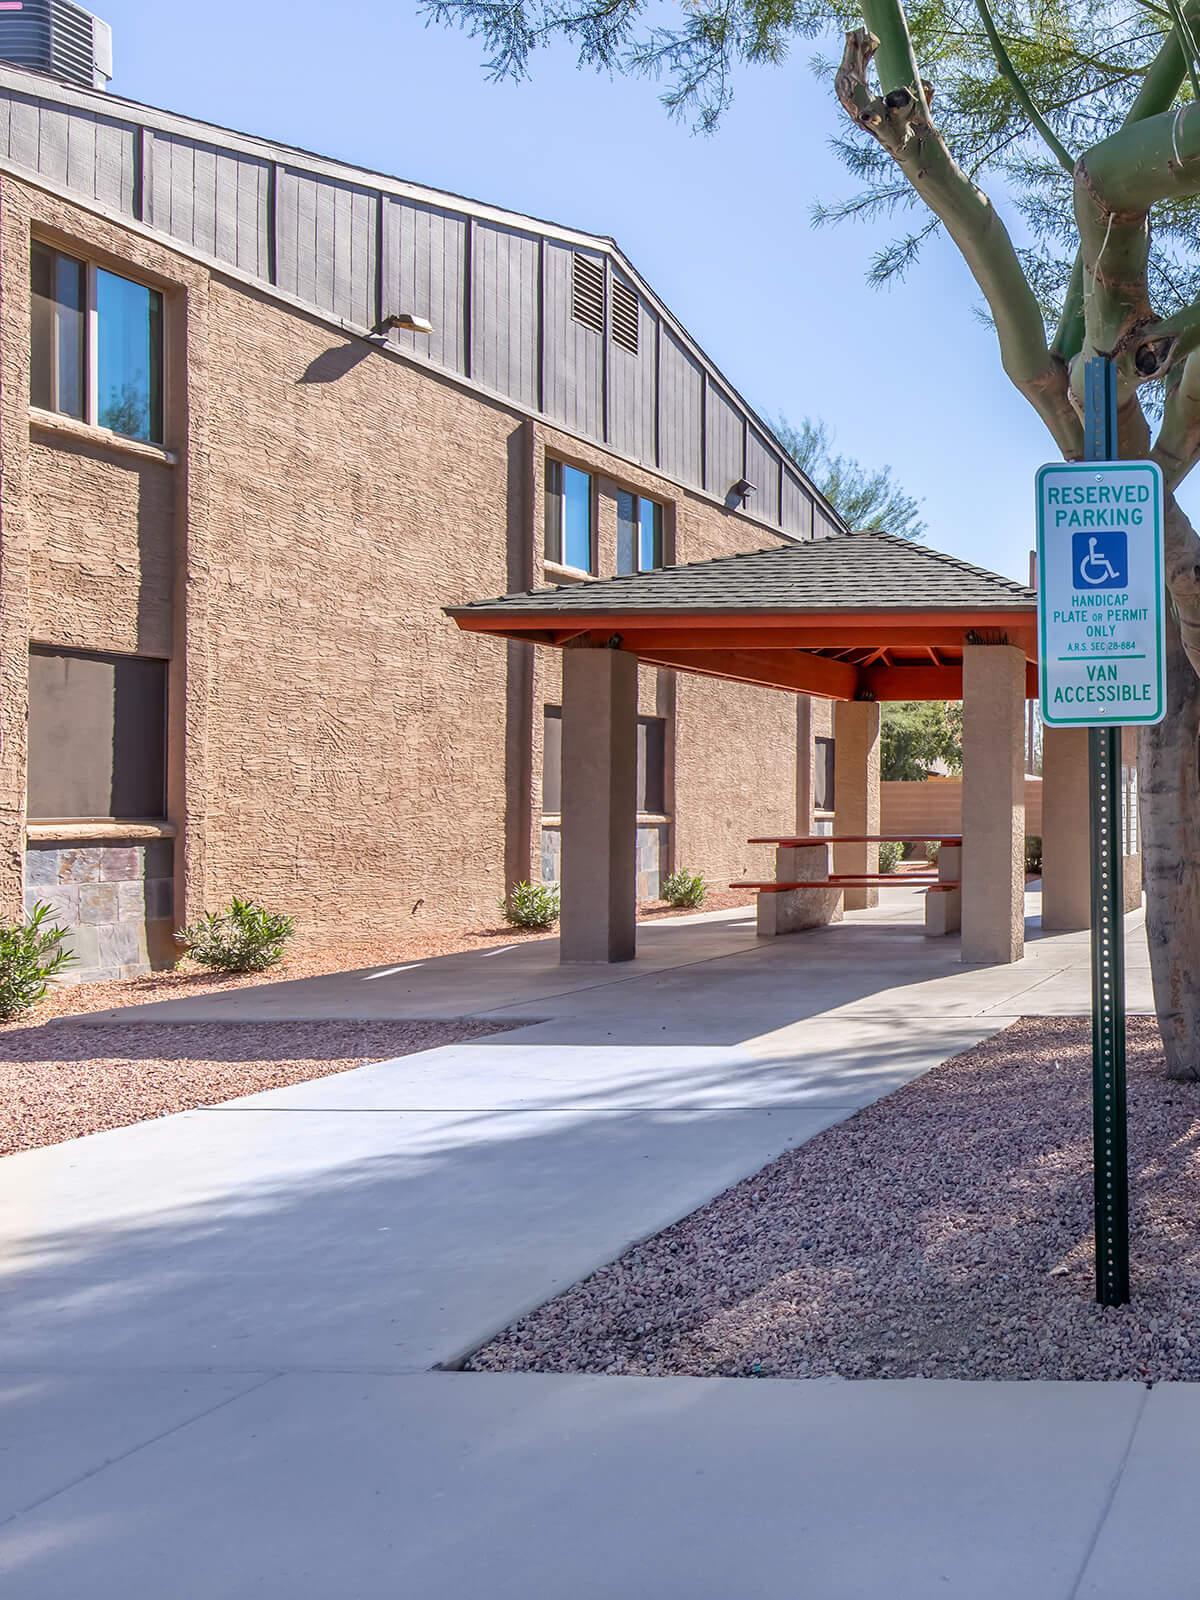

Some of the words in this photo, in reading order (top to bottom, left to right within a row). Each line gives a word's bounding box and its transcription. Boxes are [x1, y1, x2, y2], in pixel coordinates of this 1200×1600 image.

[1048, 485, 1149, 504] RESERVED
[1055, 508, 1143, 527] PARKING
[1072, 594, 1128, 607] HANDICAP
[1054, 610, 1088, 622] PLATE
[1092, 613, 1103, 621] OR
[1107, 608, 1148, 621] PERMIT
[1086, 625, 1116, 637] ONLY
[1086, 665, 1117, 681] VAN
[1054, 684, 1151, 703] ACCESSIBLE
